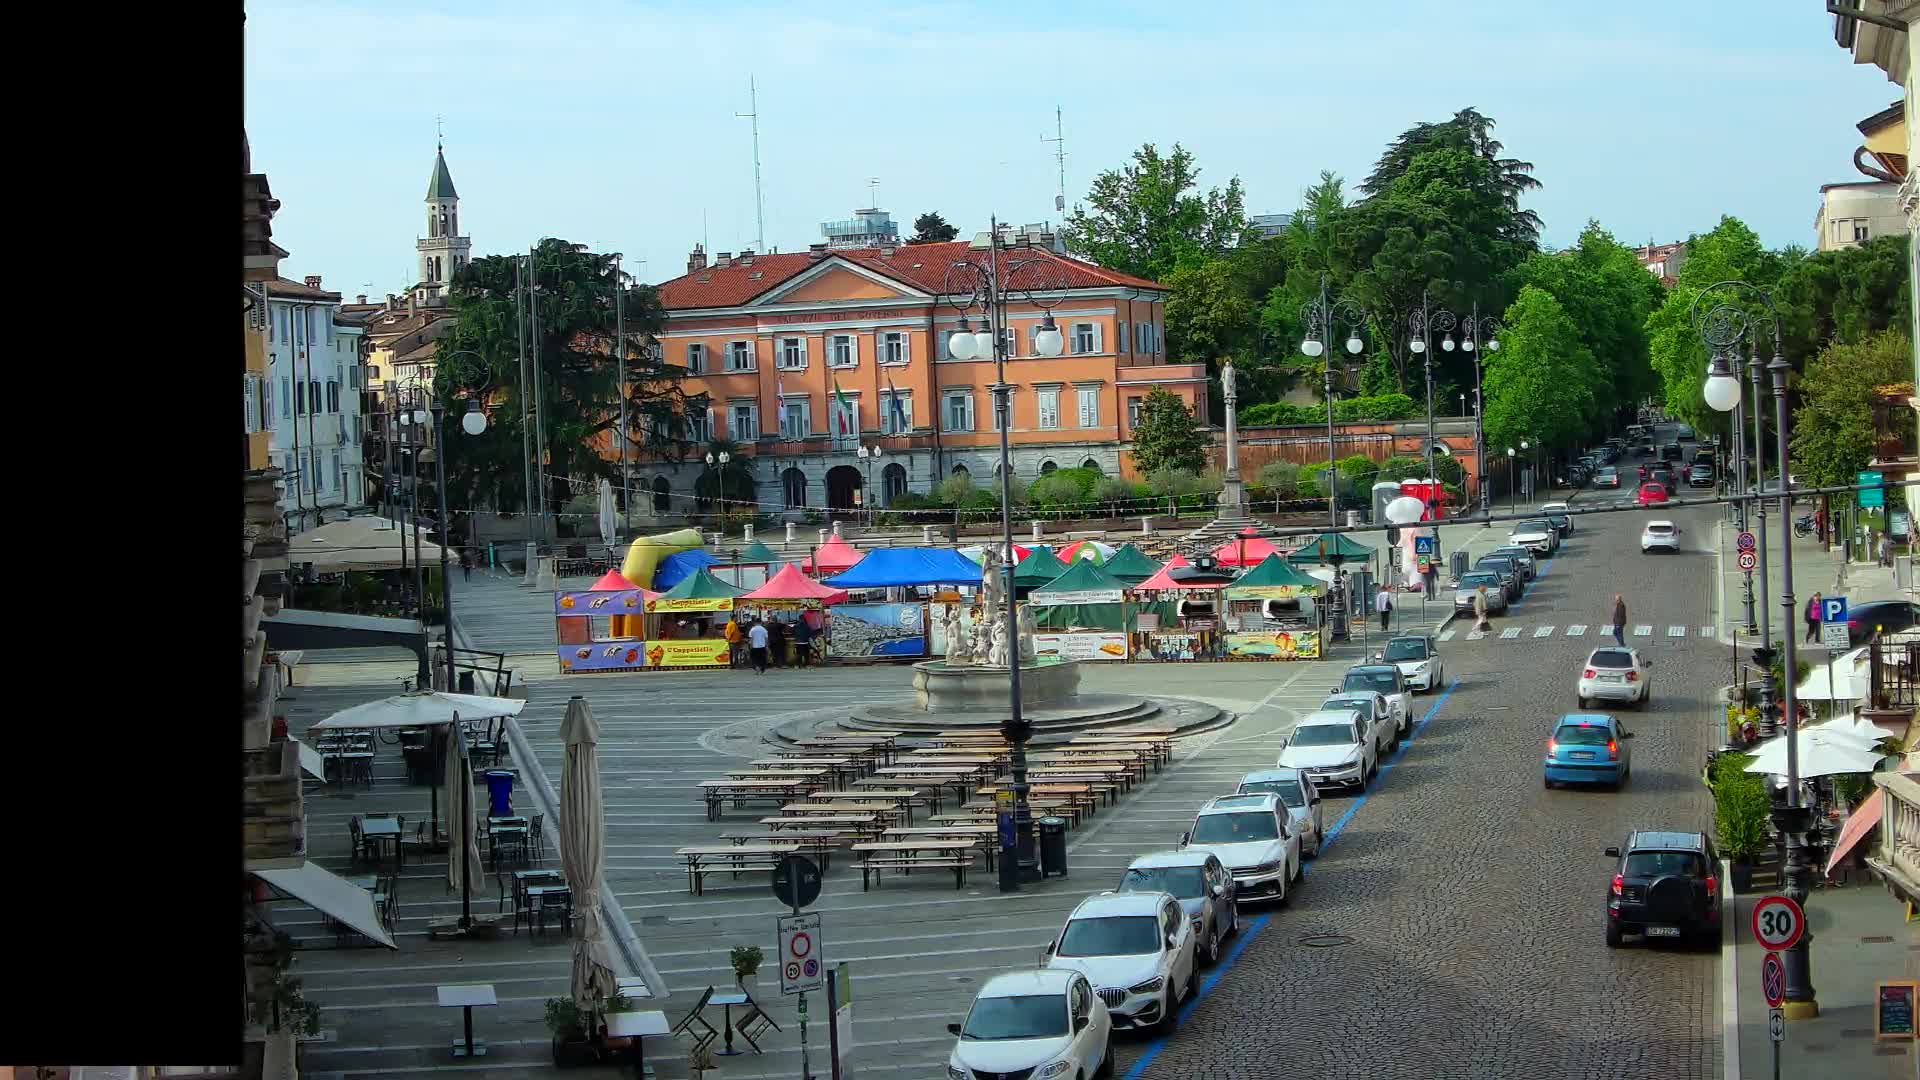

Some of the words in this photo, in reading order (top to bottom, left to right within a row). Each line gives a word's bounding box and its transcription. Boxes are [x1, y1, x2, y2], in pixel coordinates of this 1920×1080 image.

[1742, 555, 1753, 566] 20
[1826, 600, 1842, 621] P
[1761, 910, 1792, 937] 30
